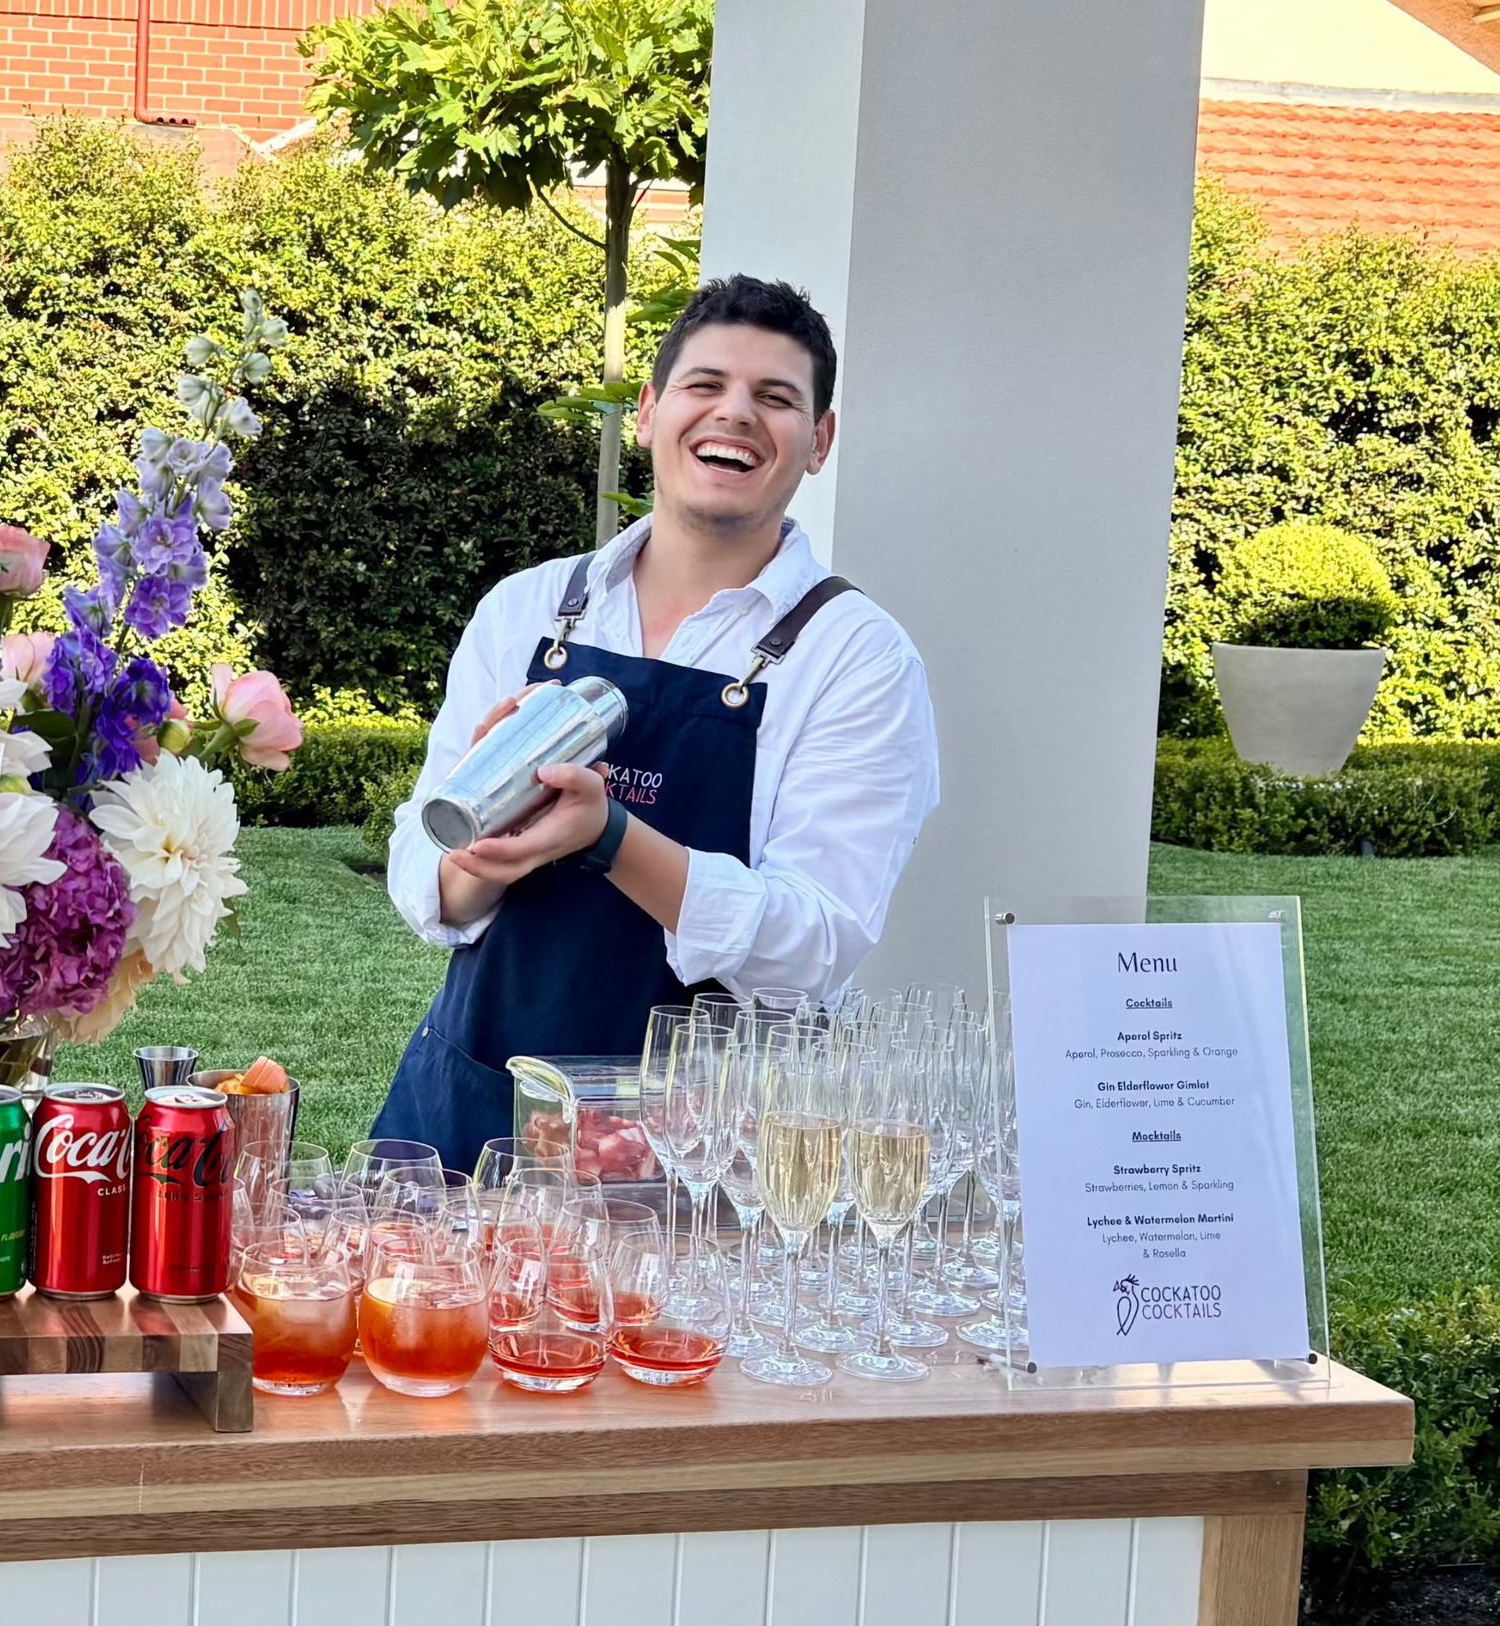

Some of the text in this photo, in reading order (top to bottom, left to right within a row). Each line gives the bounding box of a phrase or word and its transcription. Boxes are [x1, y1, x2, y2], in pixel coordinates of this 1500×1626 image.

[607, 764, 663, 788] KATOO
[605, 781, 658, 804] KTAILS
[1117, 951, 1178, 973] Menu
[1125, 997, 1173, 1009] Cocktails
[1117, 1030, 1182, 1043] Aperol Spritz
[1065, 1046, 1238, 1060] Aperol, Prosecco, Sparkling & Orange
[1097, 1079, 1210, 1091] Gin Elderflower Gimlet
[1074, 1096, 1235, 1109] Gin, Elderflower, Lime & Cucumber
[1132, 1130, 1182, 1143] Mocktails
[1113, 1163, 1202, 1176] Strawberry Spritz
[97, 1183, 127, 1196] CLASS
[1085, 1179, 1234, 1193] Strawberries, Lemon & Sparkling
[1087, 1213, 1234, 1229] Lychee & Watermelon Martini
[1102, 1230, 1221, 1245] Lychee, Watermelon, Lime
[1143, 1247, 1186, 1258] & Rosella
[1140, 1285, 1221, 1303] COCKATOO
[1142, 1302, 1222, 1320] COCKTAILS
